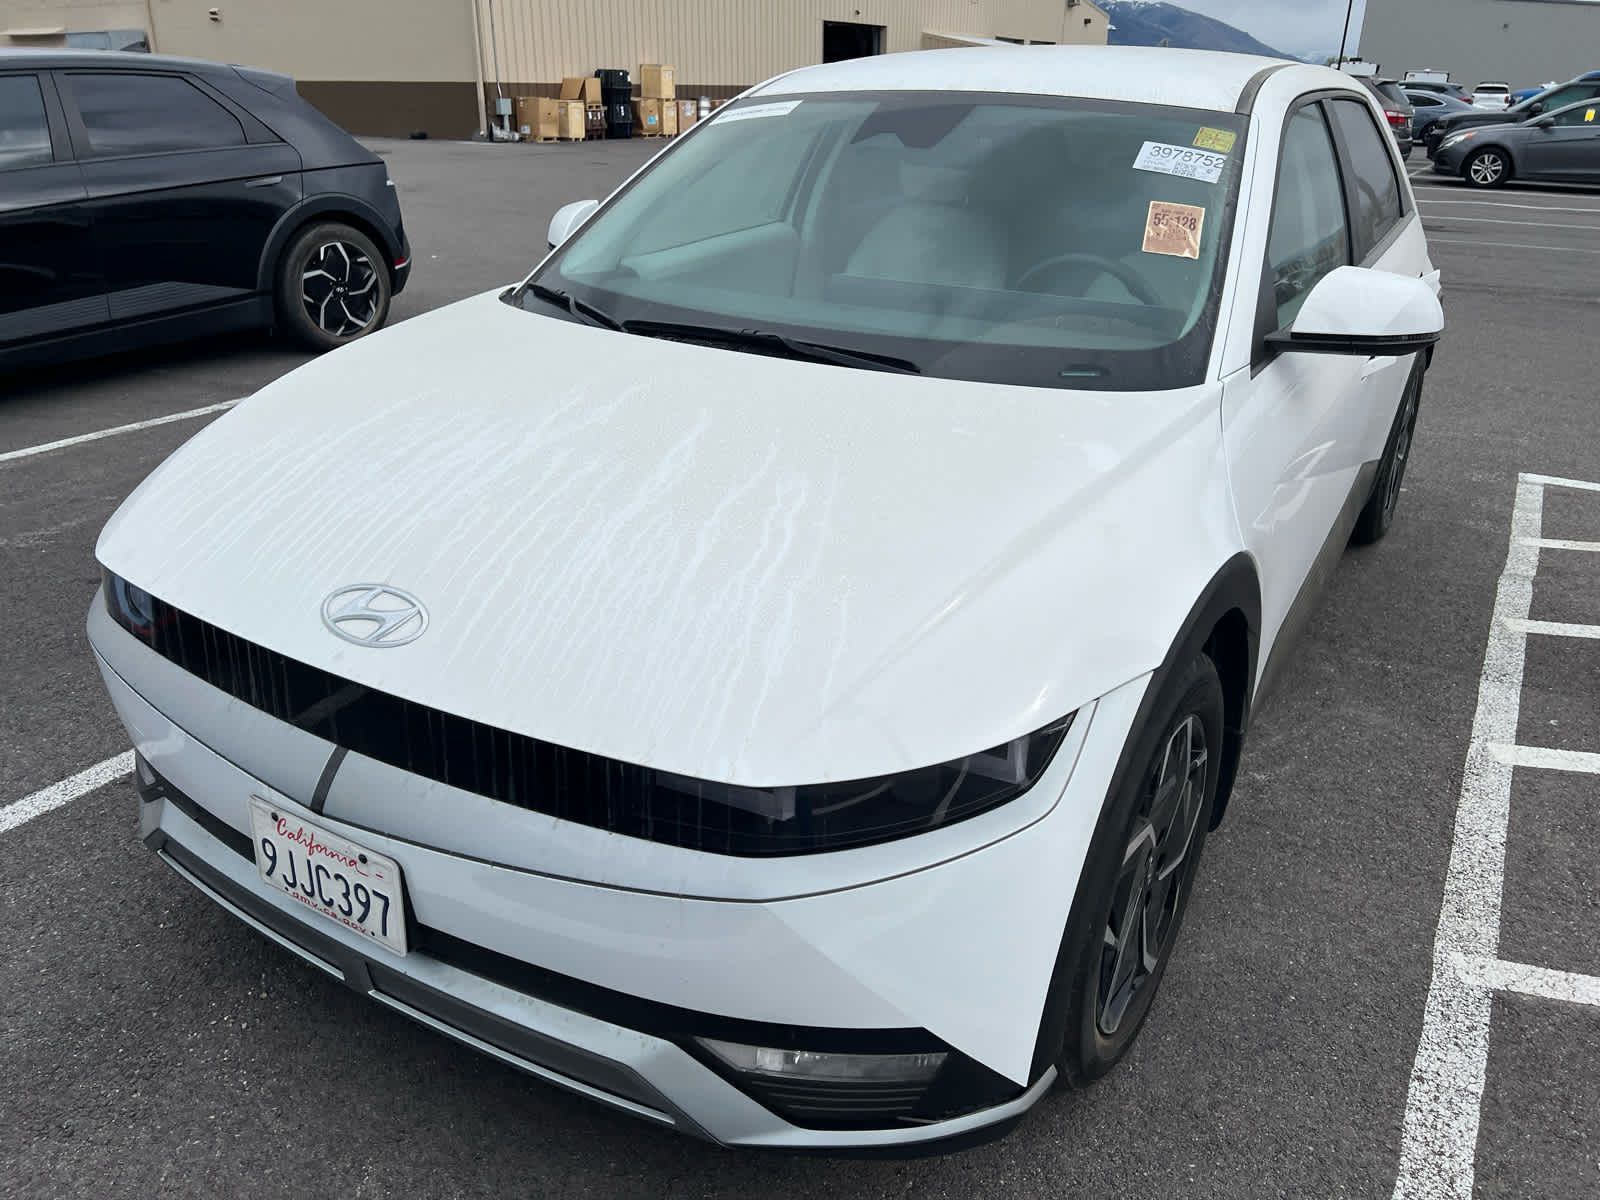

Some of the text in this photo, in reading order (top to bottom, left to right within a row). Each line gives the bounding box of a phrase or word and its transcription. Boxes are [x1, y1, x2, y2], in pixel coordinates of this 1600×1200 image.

[1150, 146, 1224, 168] 3978752
[276, 818, 368, 877] California
[261, 838, 390, 937] 9JJC397
